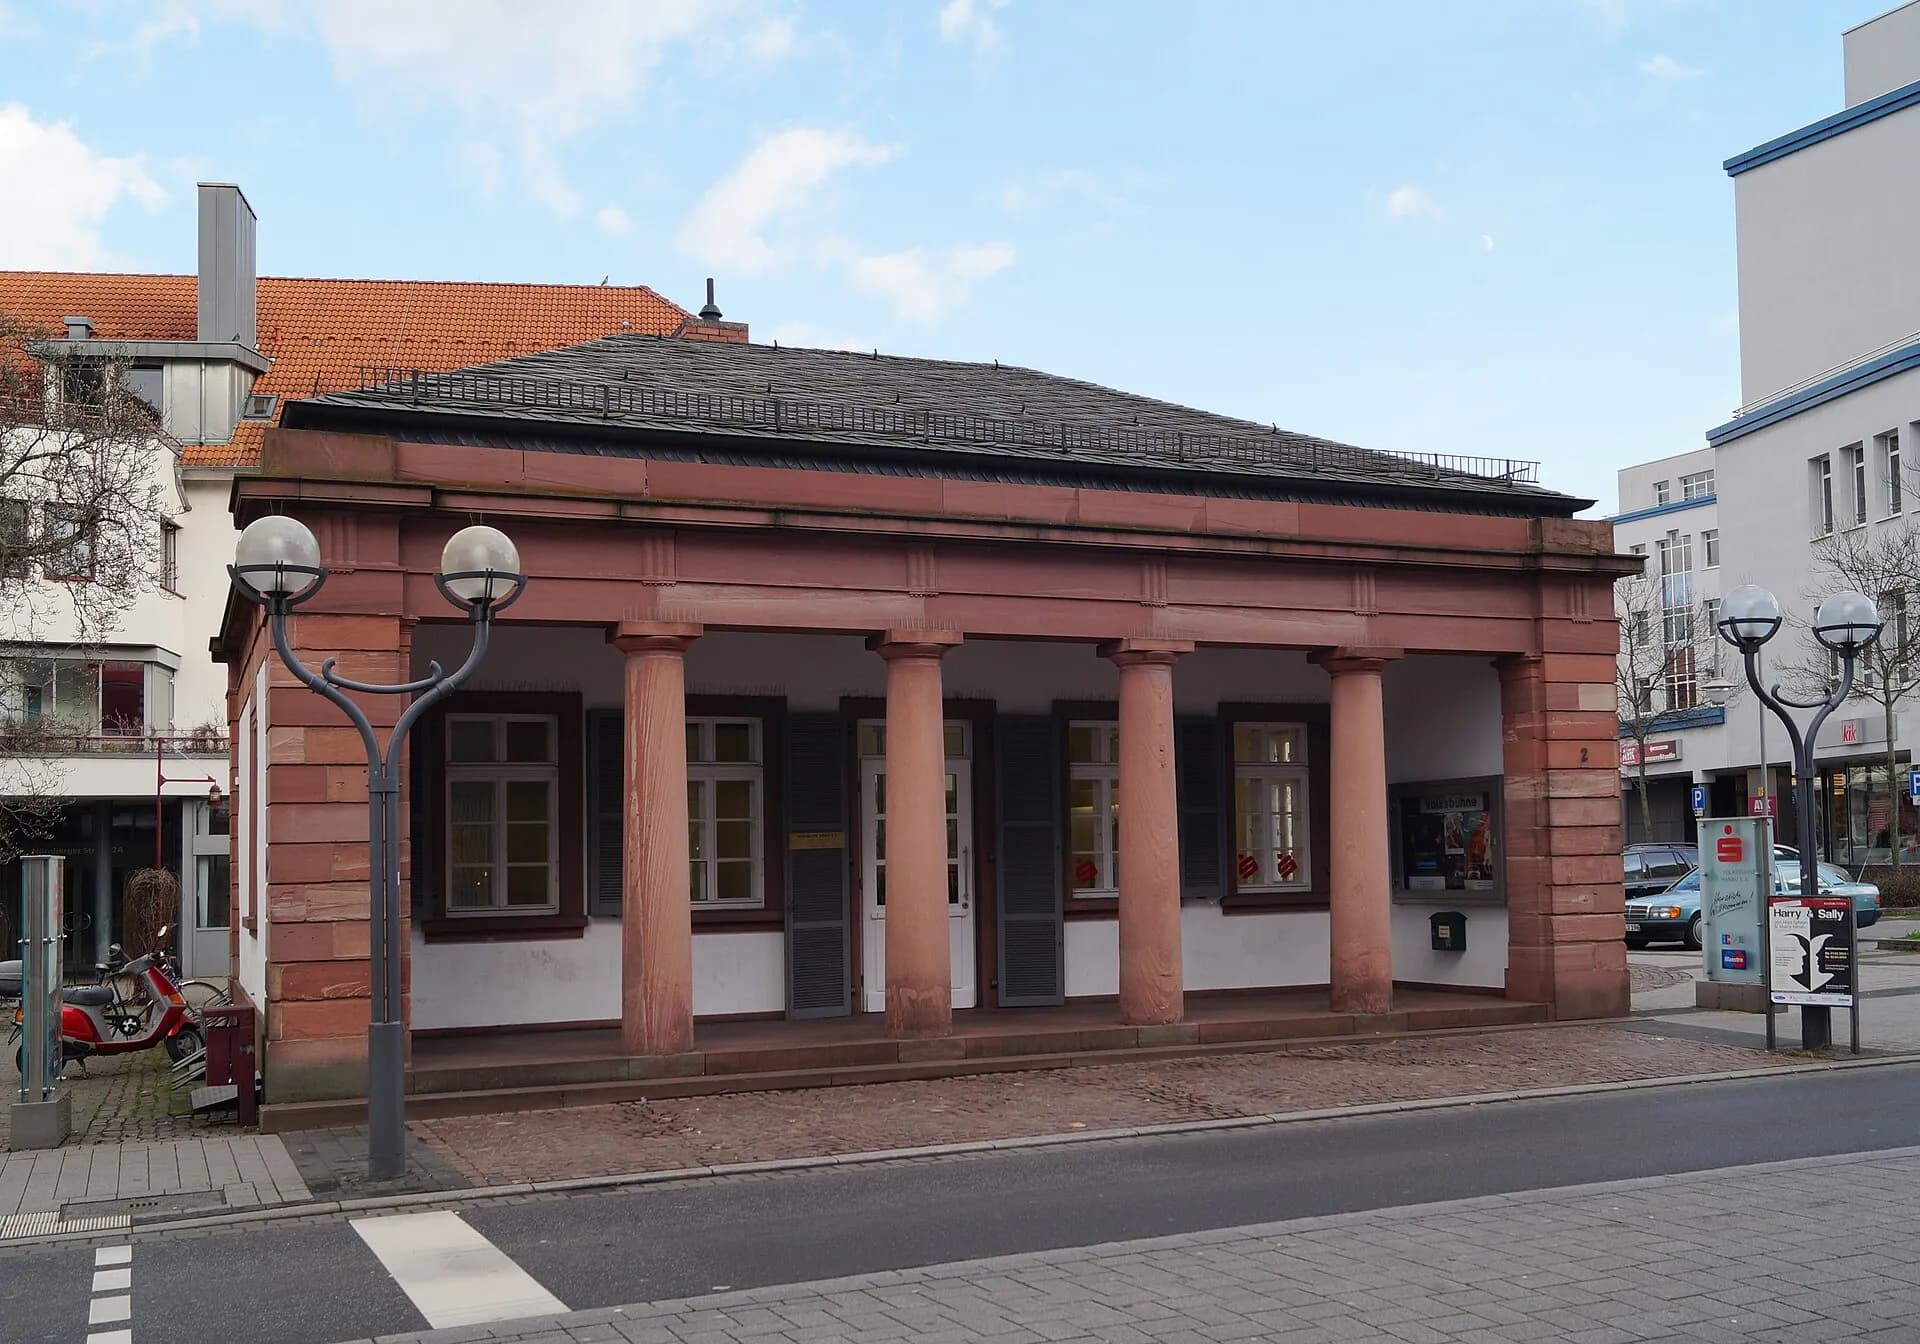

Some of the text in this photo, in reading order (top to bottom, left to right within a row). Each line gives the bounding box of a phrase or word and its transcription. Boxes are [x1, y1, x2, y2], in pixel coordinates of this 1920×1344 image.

[1843, 724, 1857, 742] kik
[1580, 747, 1588, 763] 2
[1694, 790, 1702, 808] P
[1774, 908, 1844, 921] Harry & Sally
